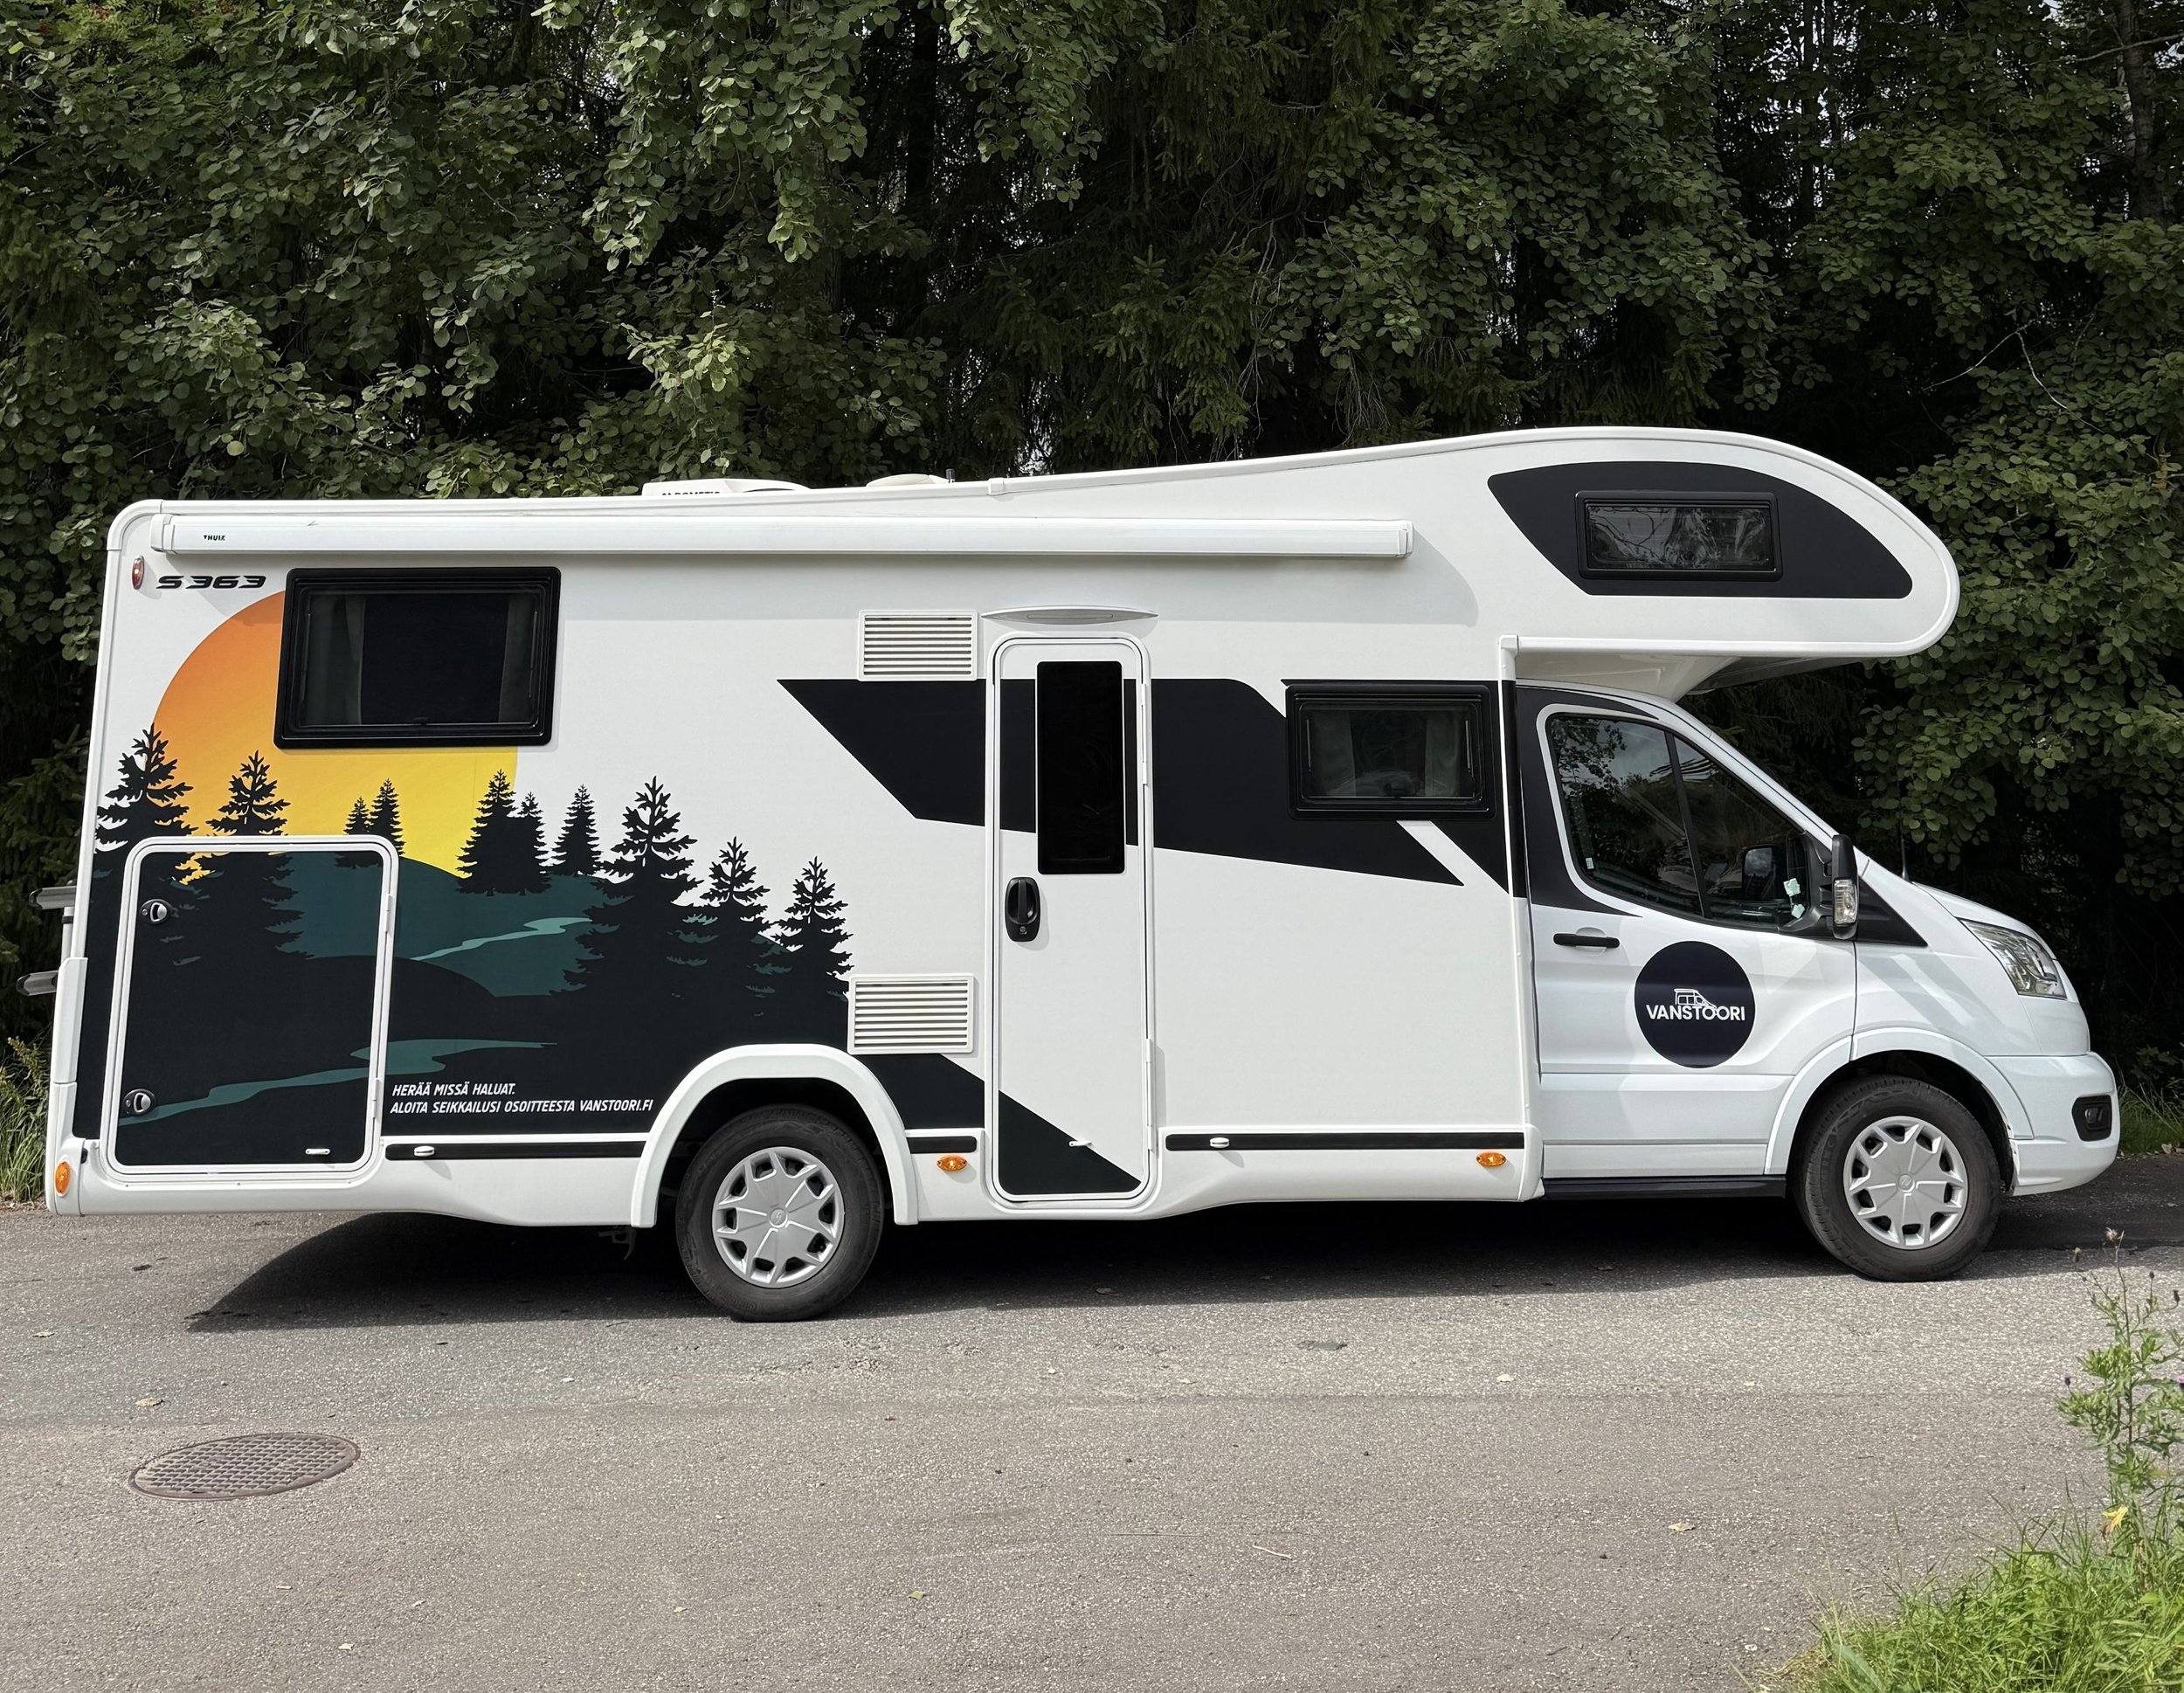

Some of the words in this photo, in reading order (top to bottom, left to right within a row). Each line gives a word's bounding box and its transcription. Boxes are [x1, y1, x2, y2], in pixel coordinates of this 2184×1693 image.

[1645, 1005, 1746, 1021] VANSTOORI
[391, 1081, 432, 1096] HERÄÄ
[433, 1081, 471, 1096] MISSÄ
[472, 1081, 516, 1096] HALUAT.
[390, 1101, 428, 1116] ALOITA
[432, 1100, 501, 1115] SEIKKAILUSI
[503, 1099, 575, 1115] OSOITTEESTA
[579, 1098, 654, 1114] VANSTOORI.FI
